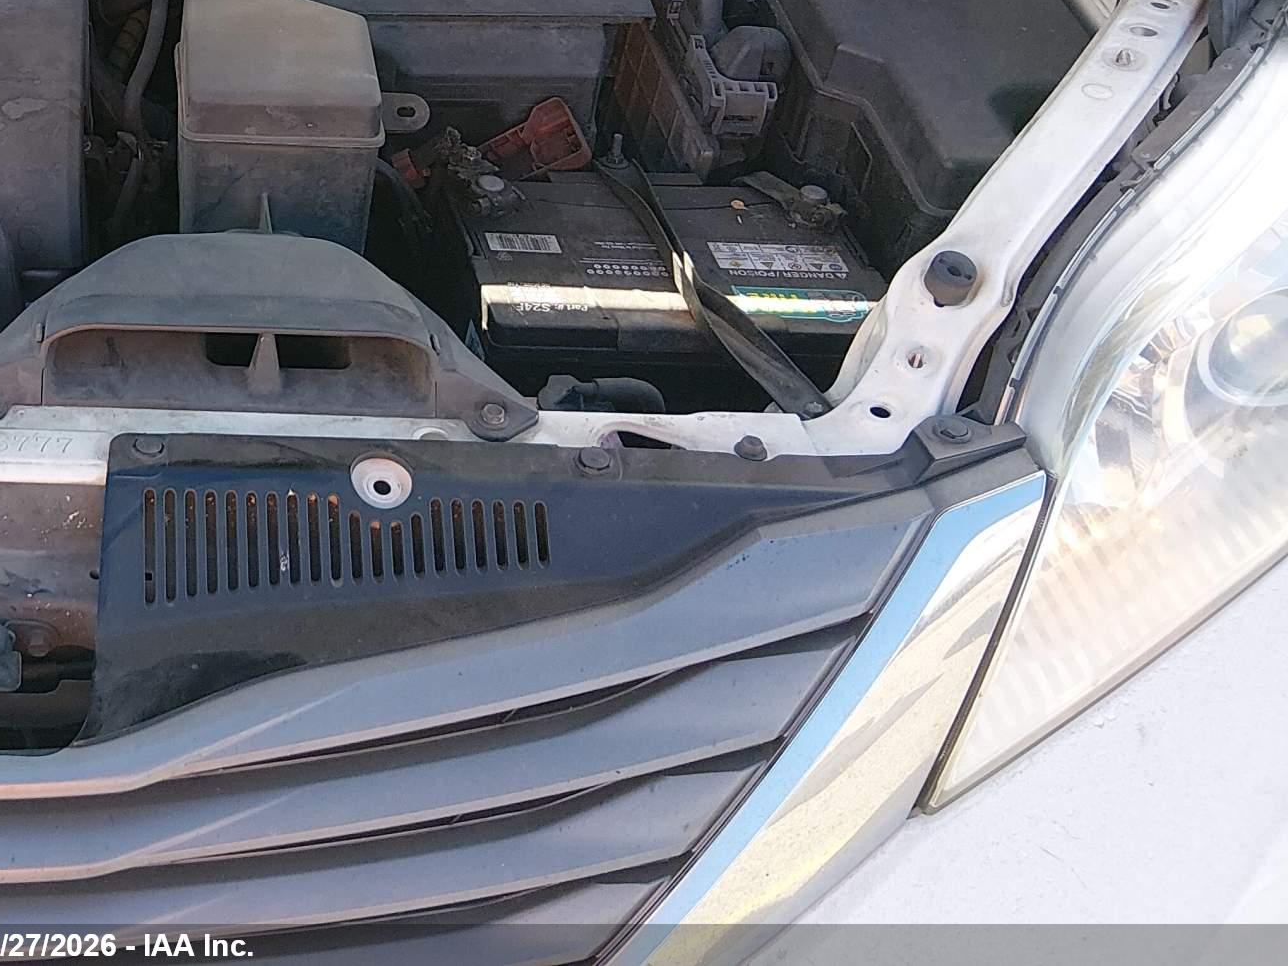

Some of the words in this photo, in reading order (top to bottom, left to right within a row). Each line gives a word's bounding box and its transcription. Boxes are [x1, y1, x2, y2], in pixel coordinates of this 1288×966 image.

[782, 270, 835, 279] DANGER
[516, 302, 552, 312] S24F
[566, 303, 589, 312] Part
